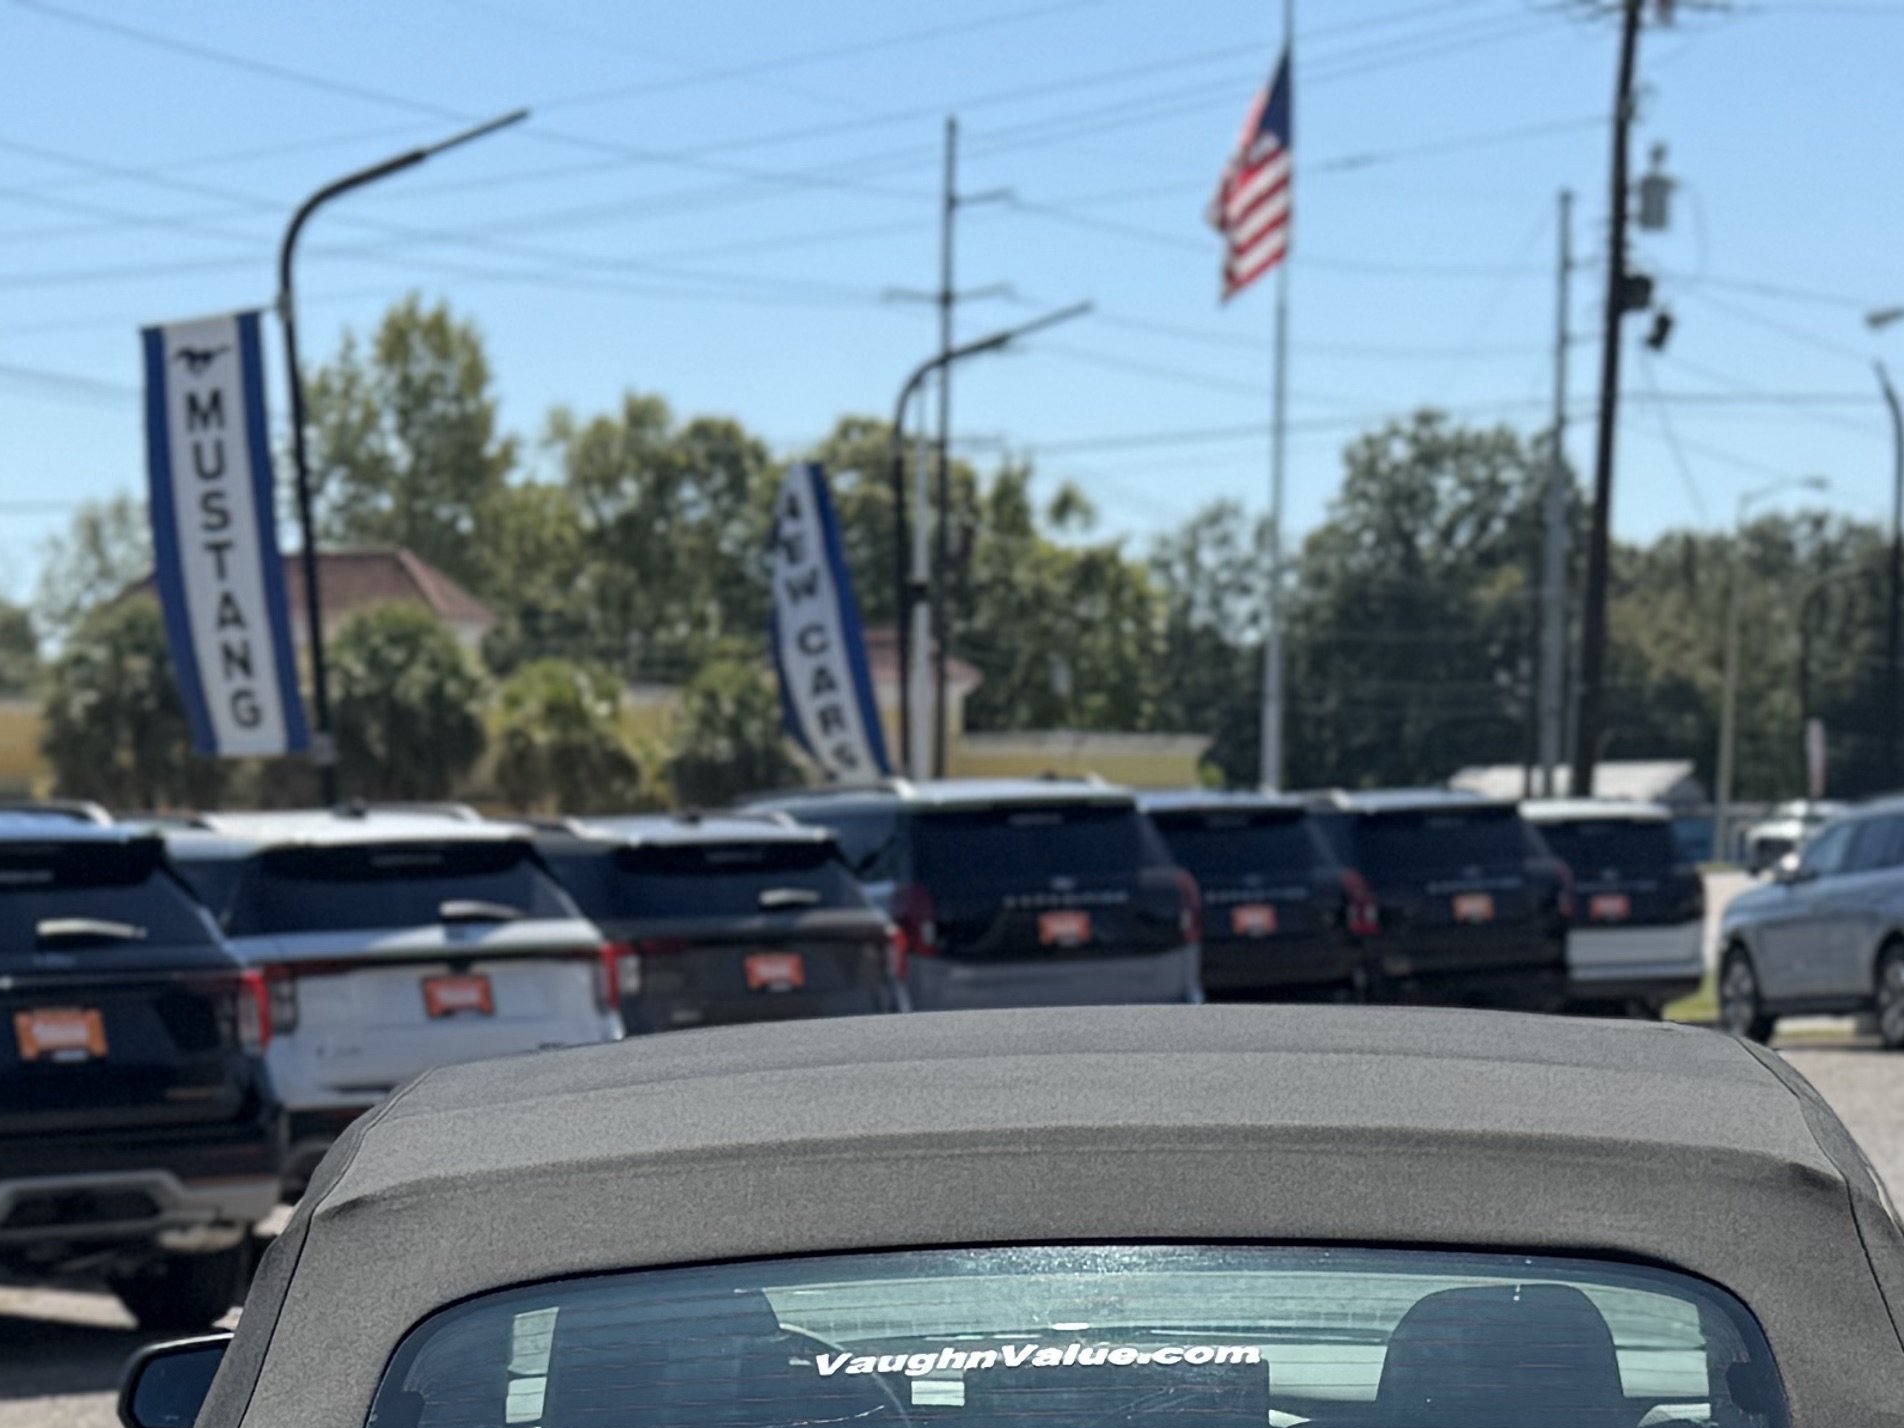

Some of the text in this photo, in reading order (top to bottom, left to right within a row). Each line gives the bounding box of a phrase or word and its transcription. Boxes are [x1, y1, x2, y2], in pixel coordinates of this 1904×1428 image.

[184, 386, 263, 730] MUSTANG
[796, 624, 858, 770] CARS
[815, 1343, 1262, 1376] VaughnValue.com
